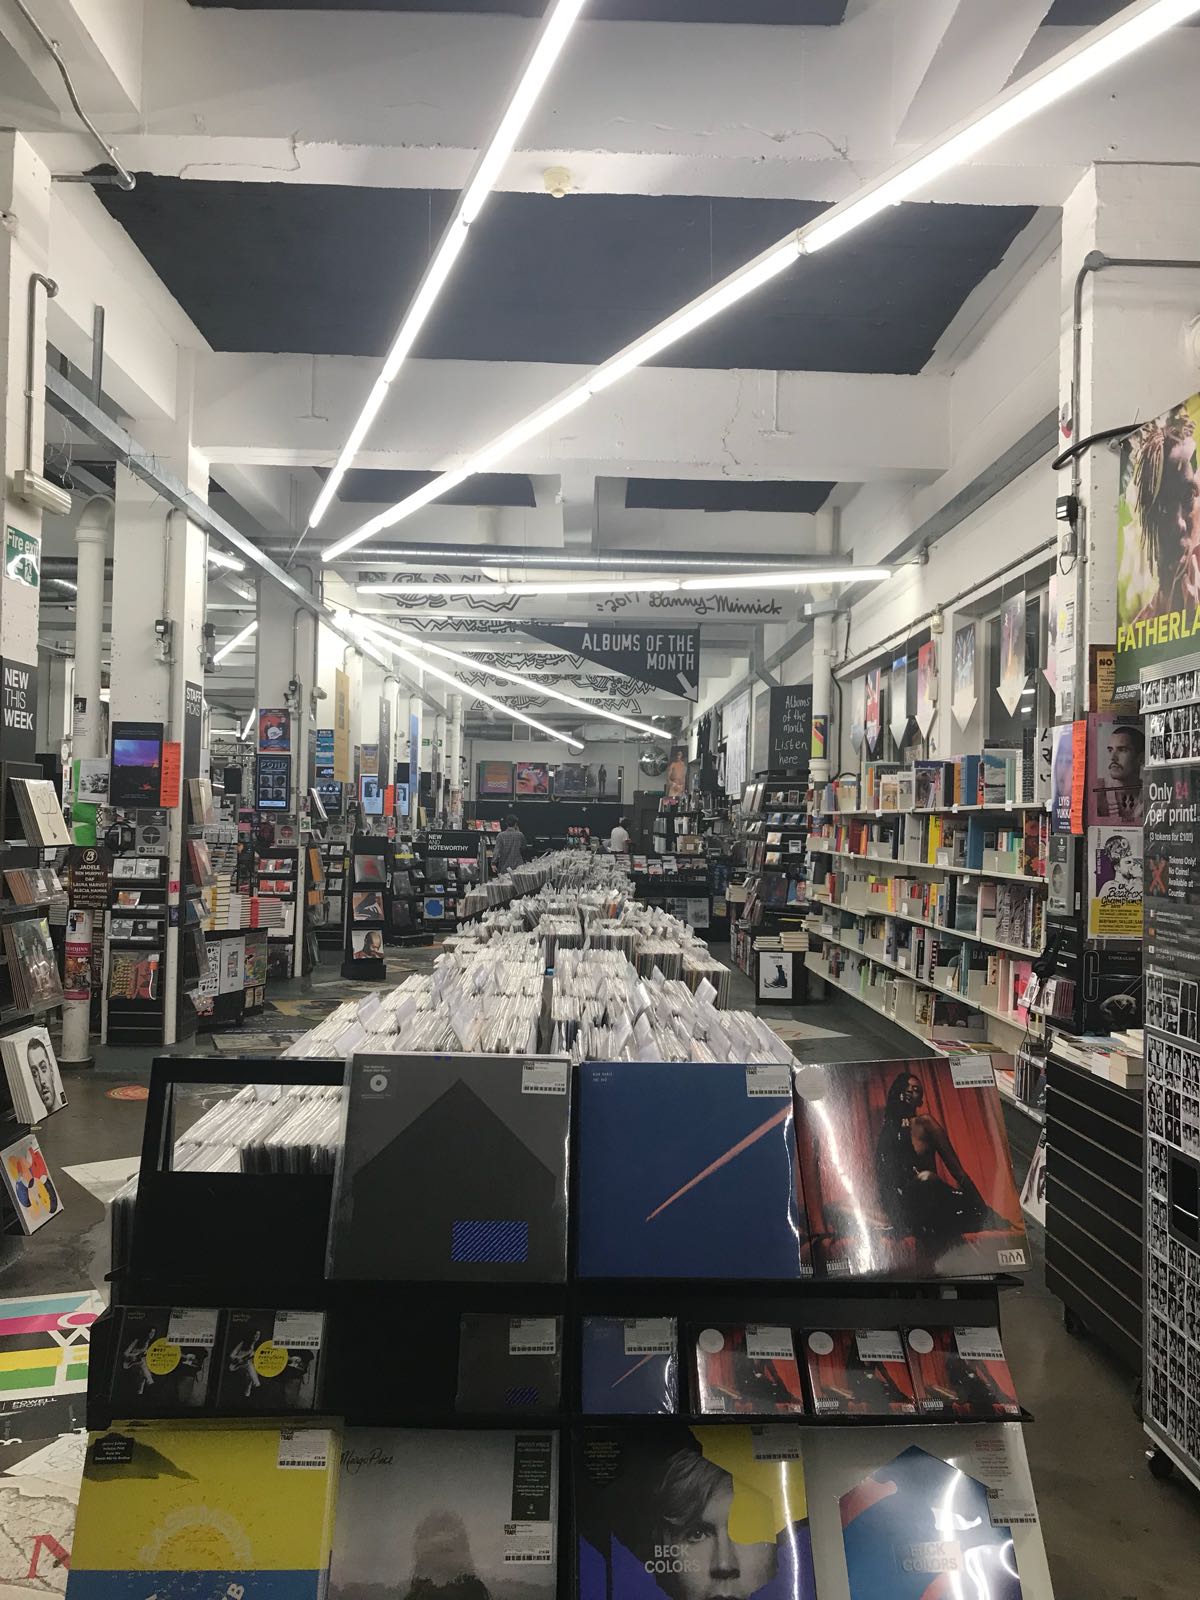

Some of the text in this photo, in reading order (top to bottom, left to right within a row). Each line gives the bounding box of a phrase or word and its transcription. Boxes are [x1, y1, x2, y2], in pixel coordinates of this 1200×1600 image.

[7, 530, 39, 557] Fire exit
[581, 633, 694, 652] ALBUMS OF THE
[647, 653, 694, 670] MONTH
[4, 668, 29, 690] NEW
[4, 688, 26, 709] THIS
[186, 687, 202, 703] STAFF
[785, 695, 811, 709] Albums
[186, 701, 200, 717] PICKS
[782, 708, 806, 722] of the
[4, 708, 34, 731] WEEK
[783, 722, 804, 734] month
[774, 738, 808, 751] Listen
[779, 752, 799, 765] here
[1149, 781, 1189, 804] Only £4
[1149, 803, 1197, 826] per print!
[1155, 832, 1171, 841] tokens
[1171, 832, 1179, 841] for
[1168, 856, 1197, 867] Tokens Only!
[1168, 867, 1190, 876] No Coins!
[1168, 877, 1194, 888] Available at
[1168, 889, 1186, 898] Counter
[654, 1544, 689, 1558] BECK
[644, 1560, 701, 1574] COLORS
